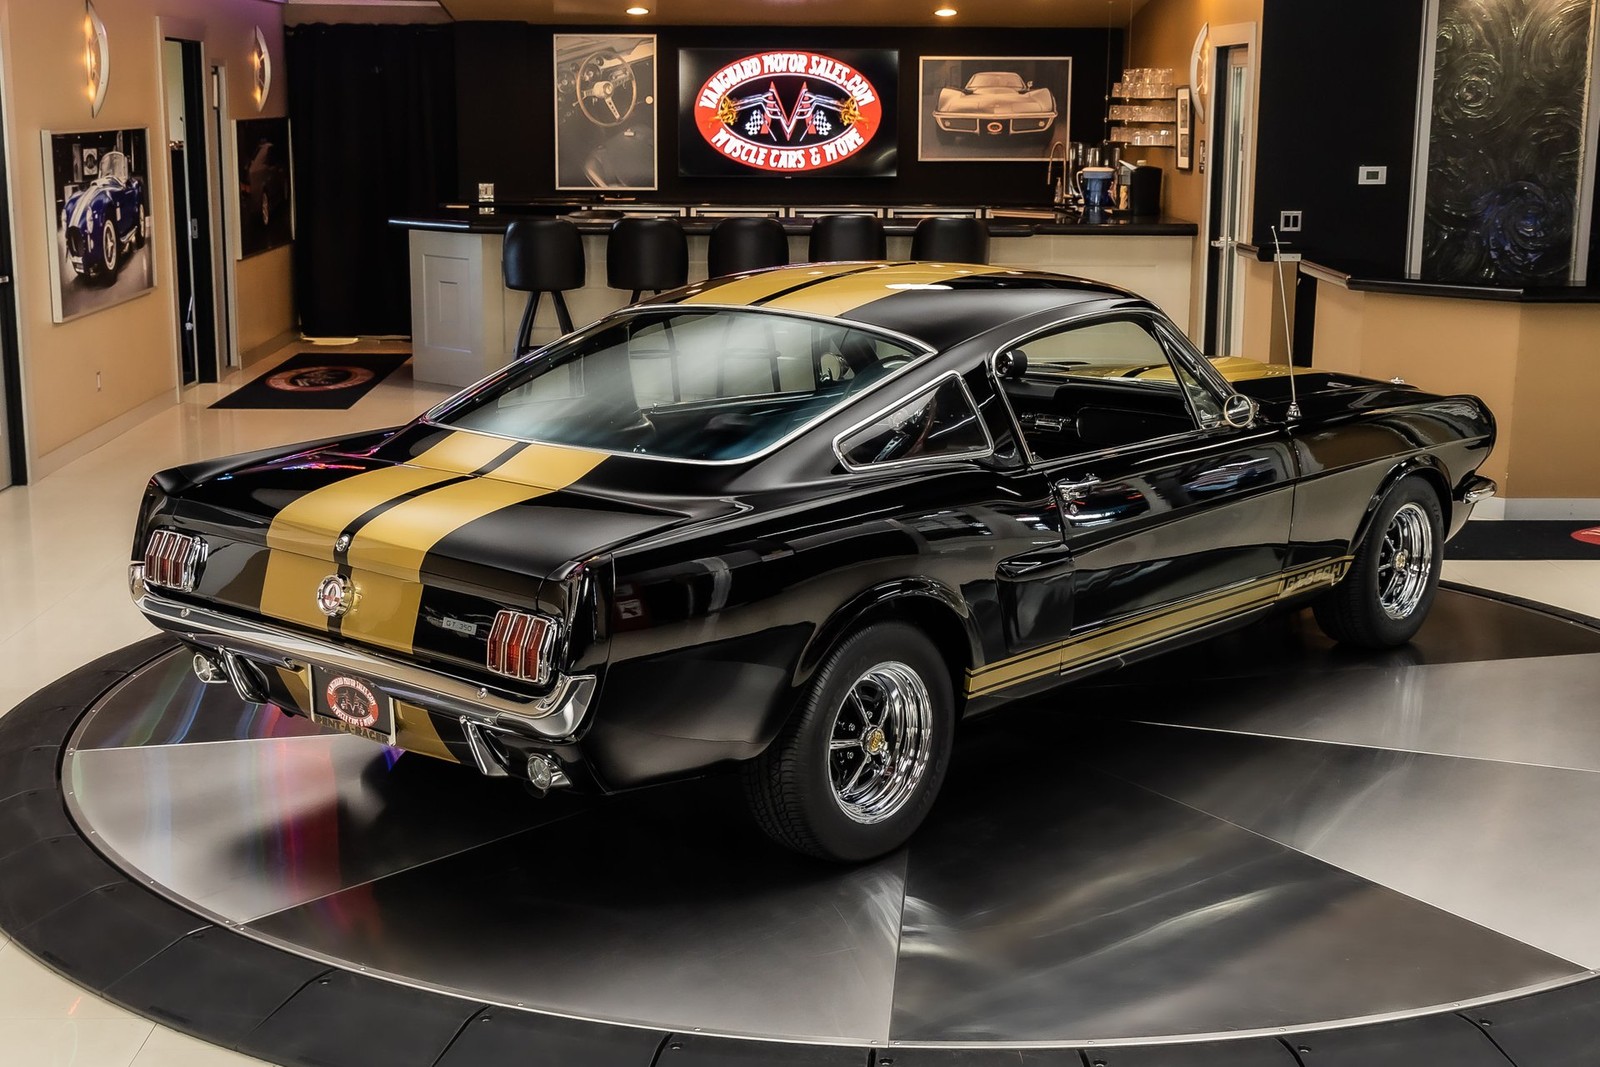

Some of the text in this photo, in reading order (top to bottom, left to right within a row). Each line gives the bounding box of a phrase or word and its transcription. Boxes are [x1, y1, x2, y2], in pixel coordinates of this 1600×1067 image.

[699, 53, 876, 109] VANGUARD MOTOR SALES.COM
[711, 127, 865, 169] MUSCLE CARS & MORE
